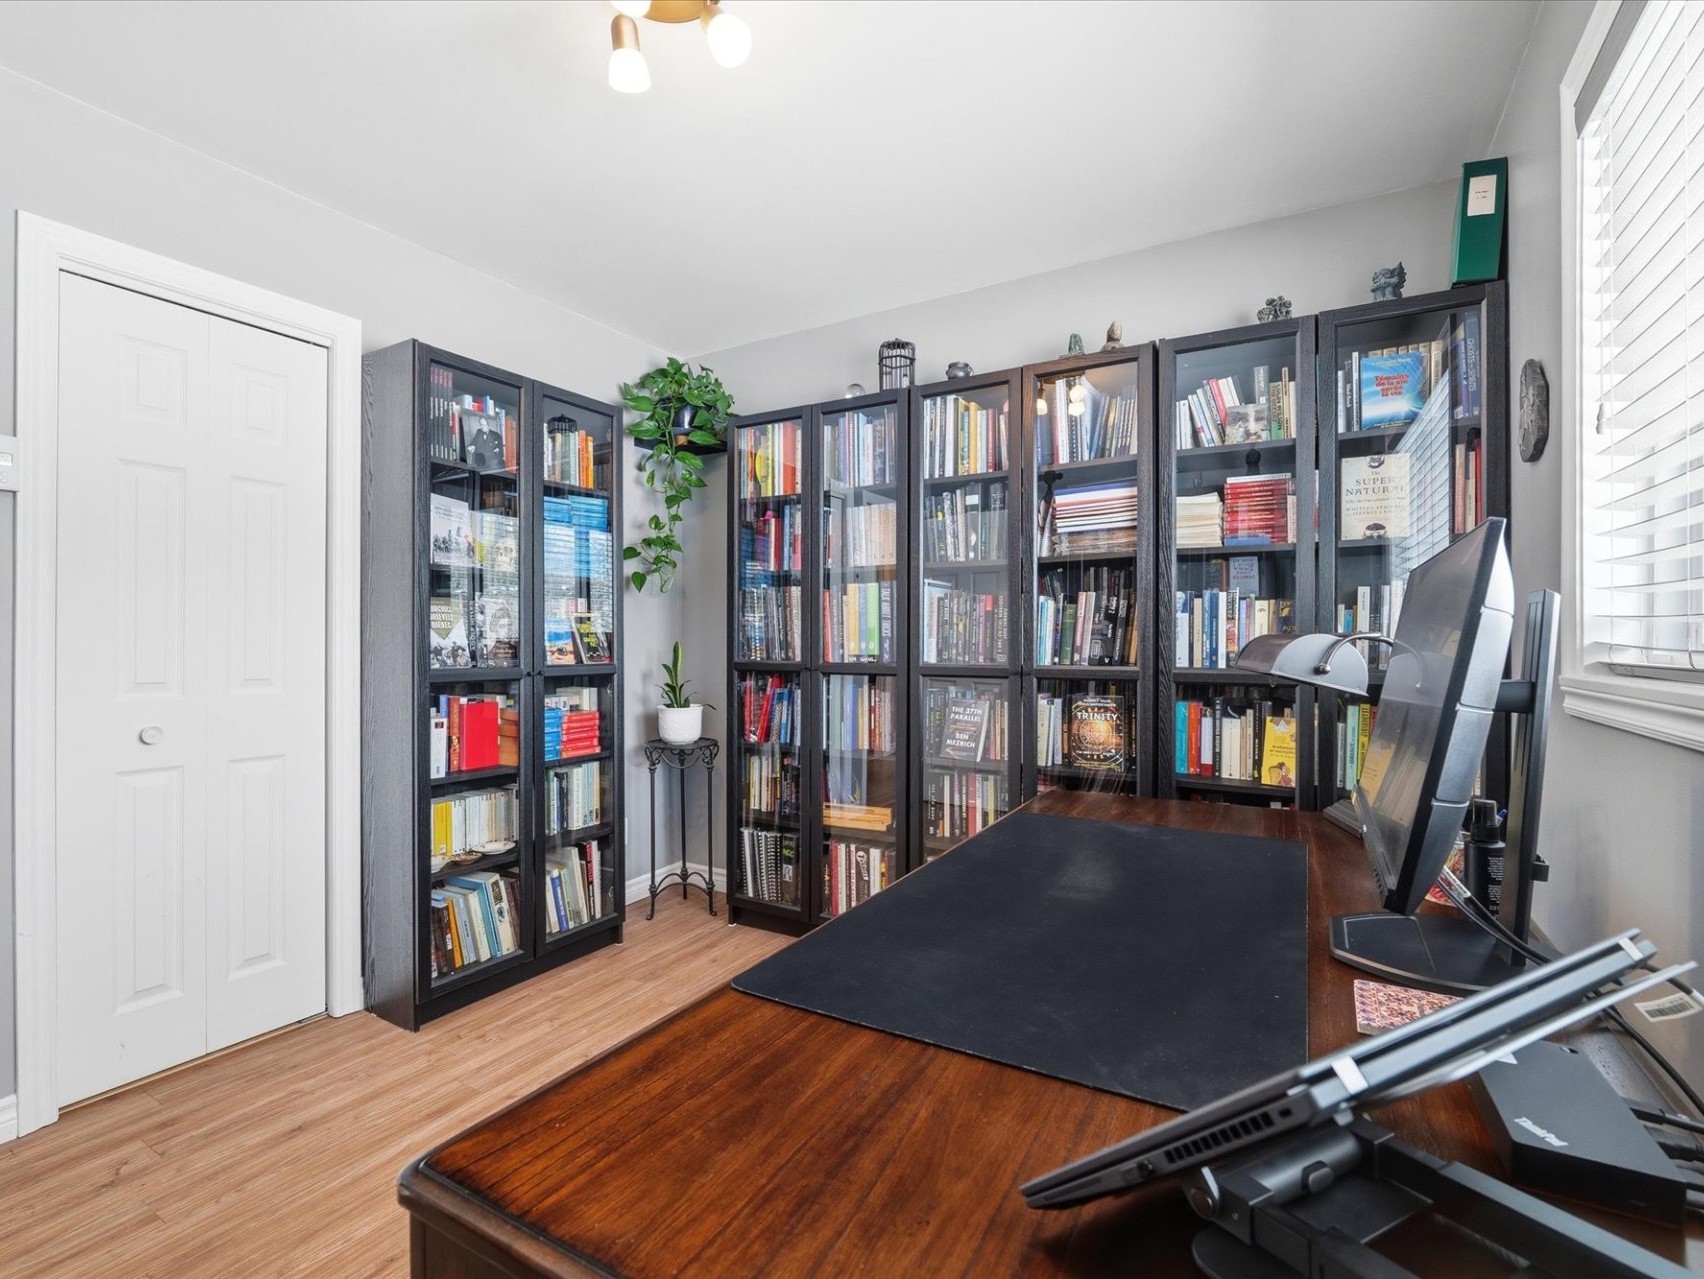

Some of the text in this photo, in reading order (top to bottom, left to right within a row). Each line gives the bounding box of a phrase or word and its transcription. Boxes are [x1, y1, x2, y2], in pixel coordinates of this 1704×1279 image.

[950, 713, 981, 722] PARALLEL
[1077, 711, 1118, 722] TRINITY
[946, 739, 976, 748] MEZRICH
[1514, 1116, 1568, 1147] ThinkPad
